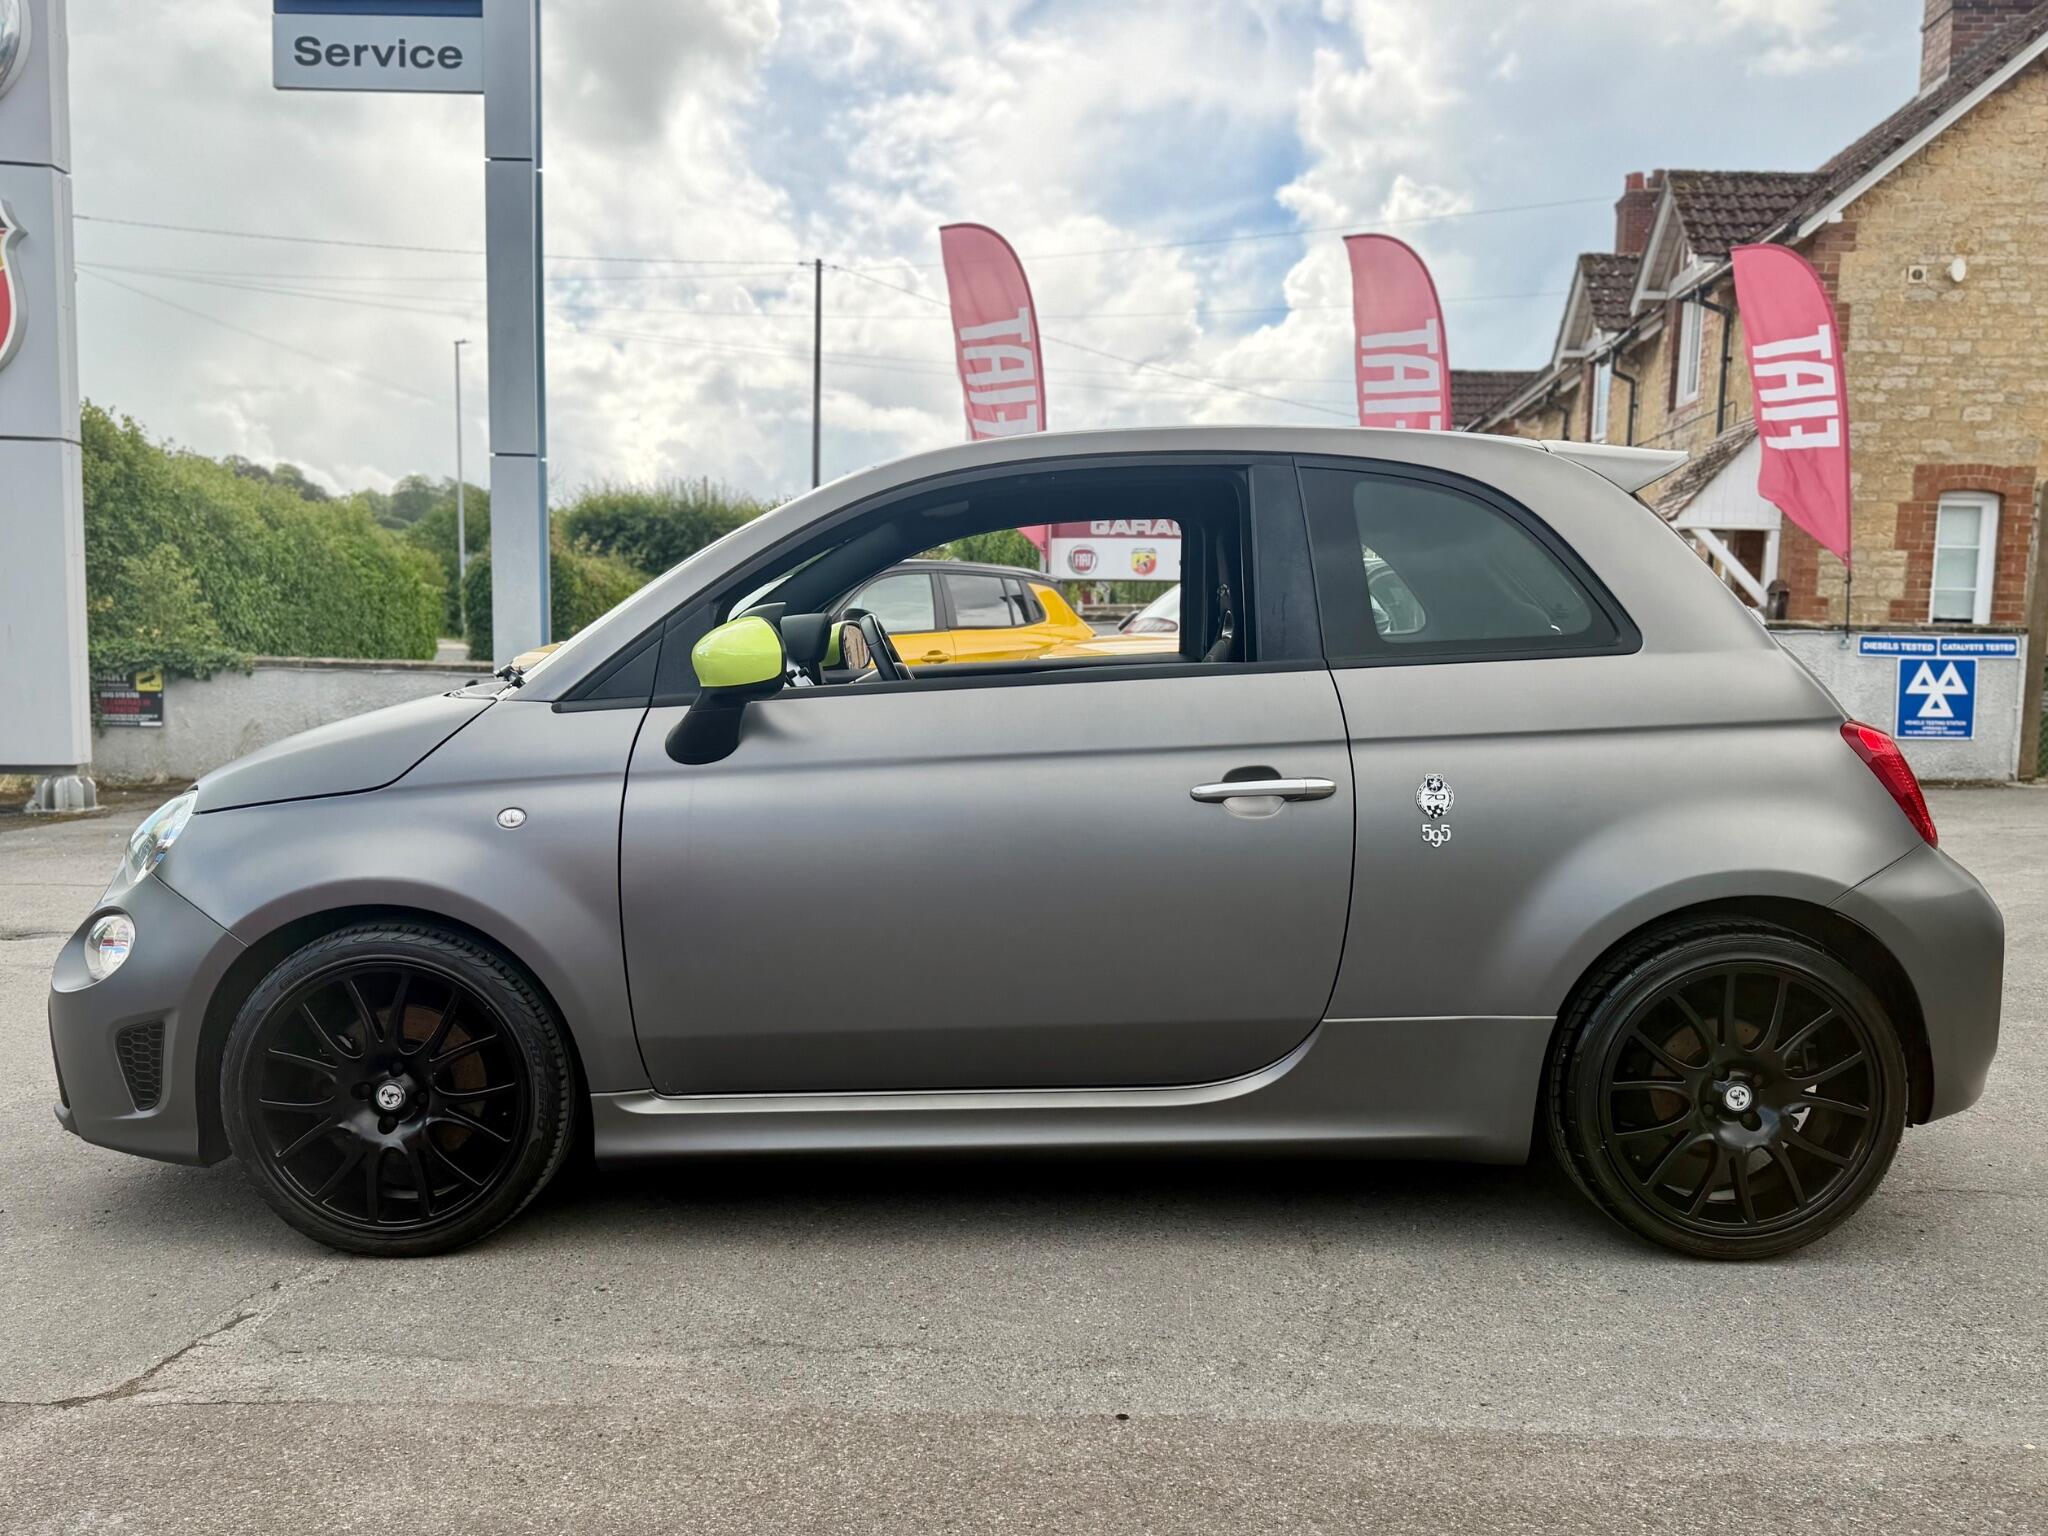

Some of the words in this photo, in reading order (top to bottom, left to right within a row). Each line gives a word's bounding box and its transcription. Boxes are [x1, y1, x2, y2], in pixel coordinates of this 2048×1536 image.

[294, 36, 463, 69] Service
[1862, 641, 1899, 651] DIESELS
[1900, 642, 1935, 652] TESTED
[1942, 643, 1984, 652] CATALYSTS
[1985, 643, 2015, 652] TESTED
[1422, 824, 1451, 847] 595
